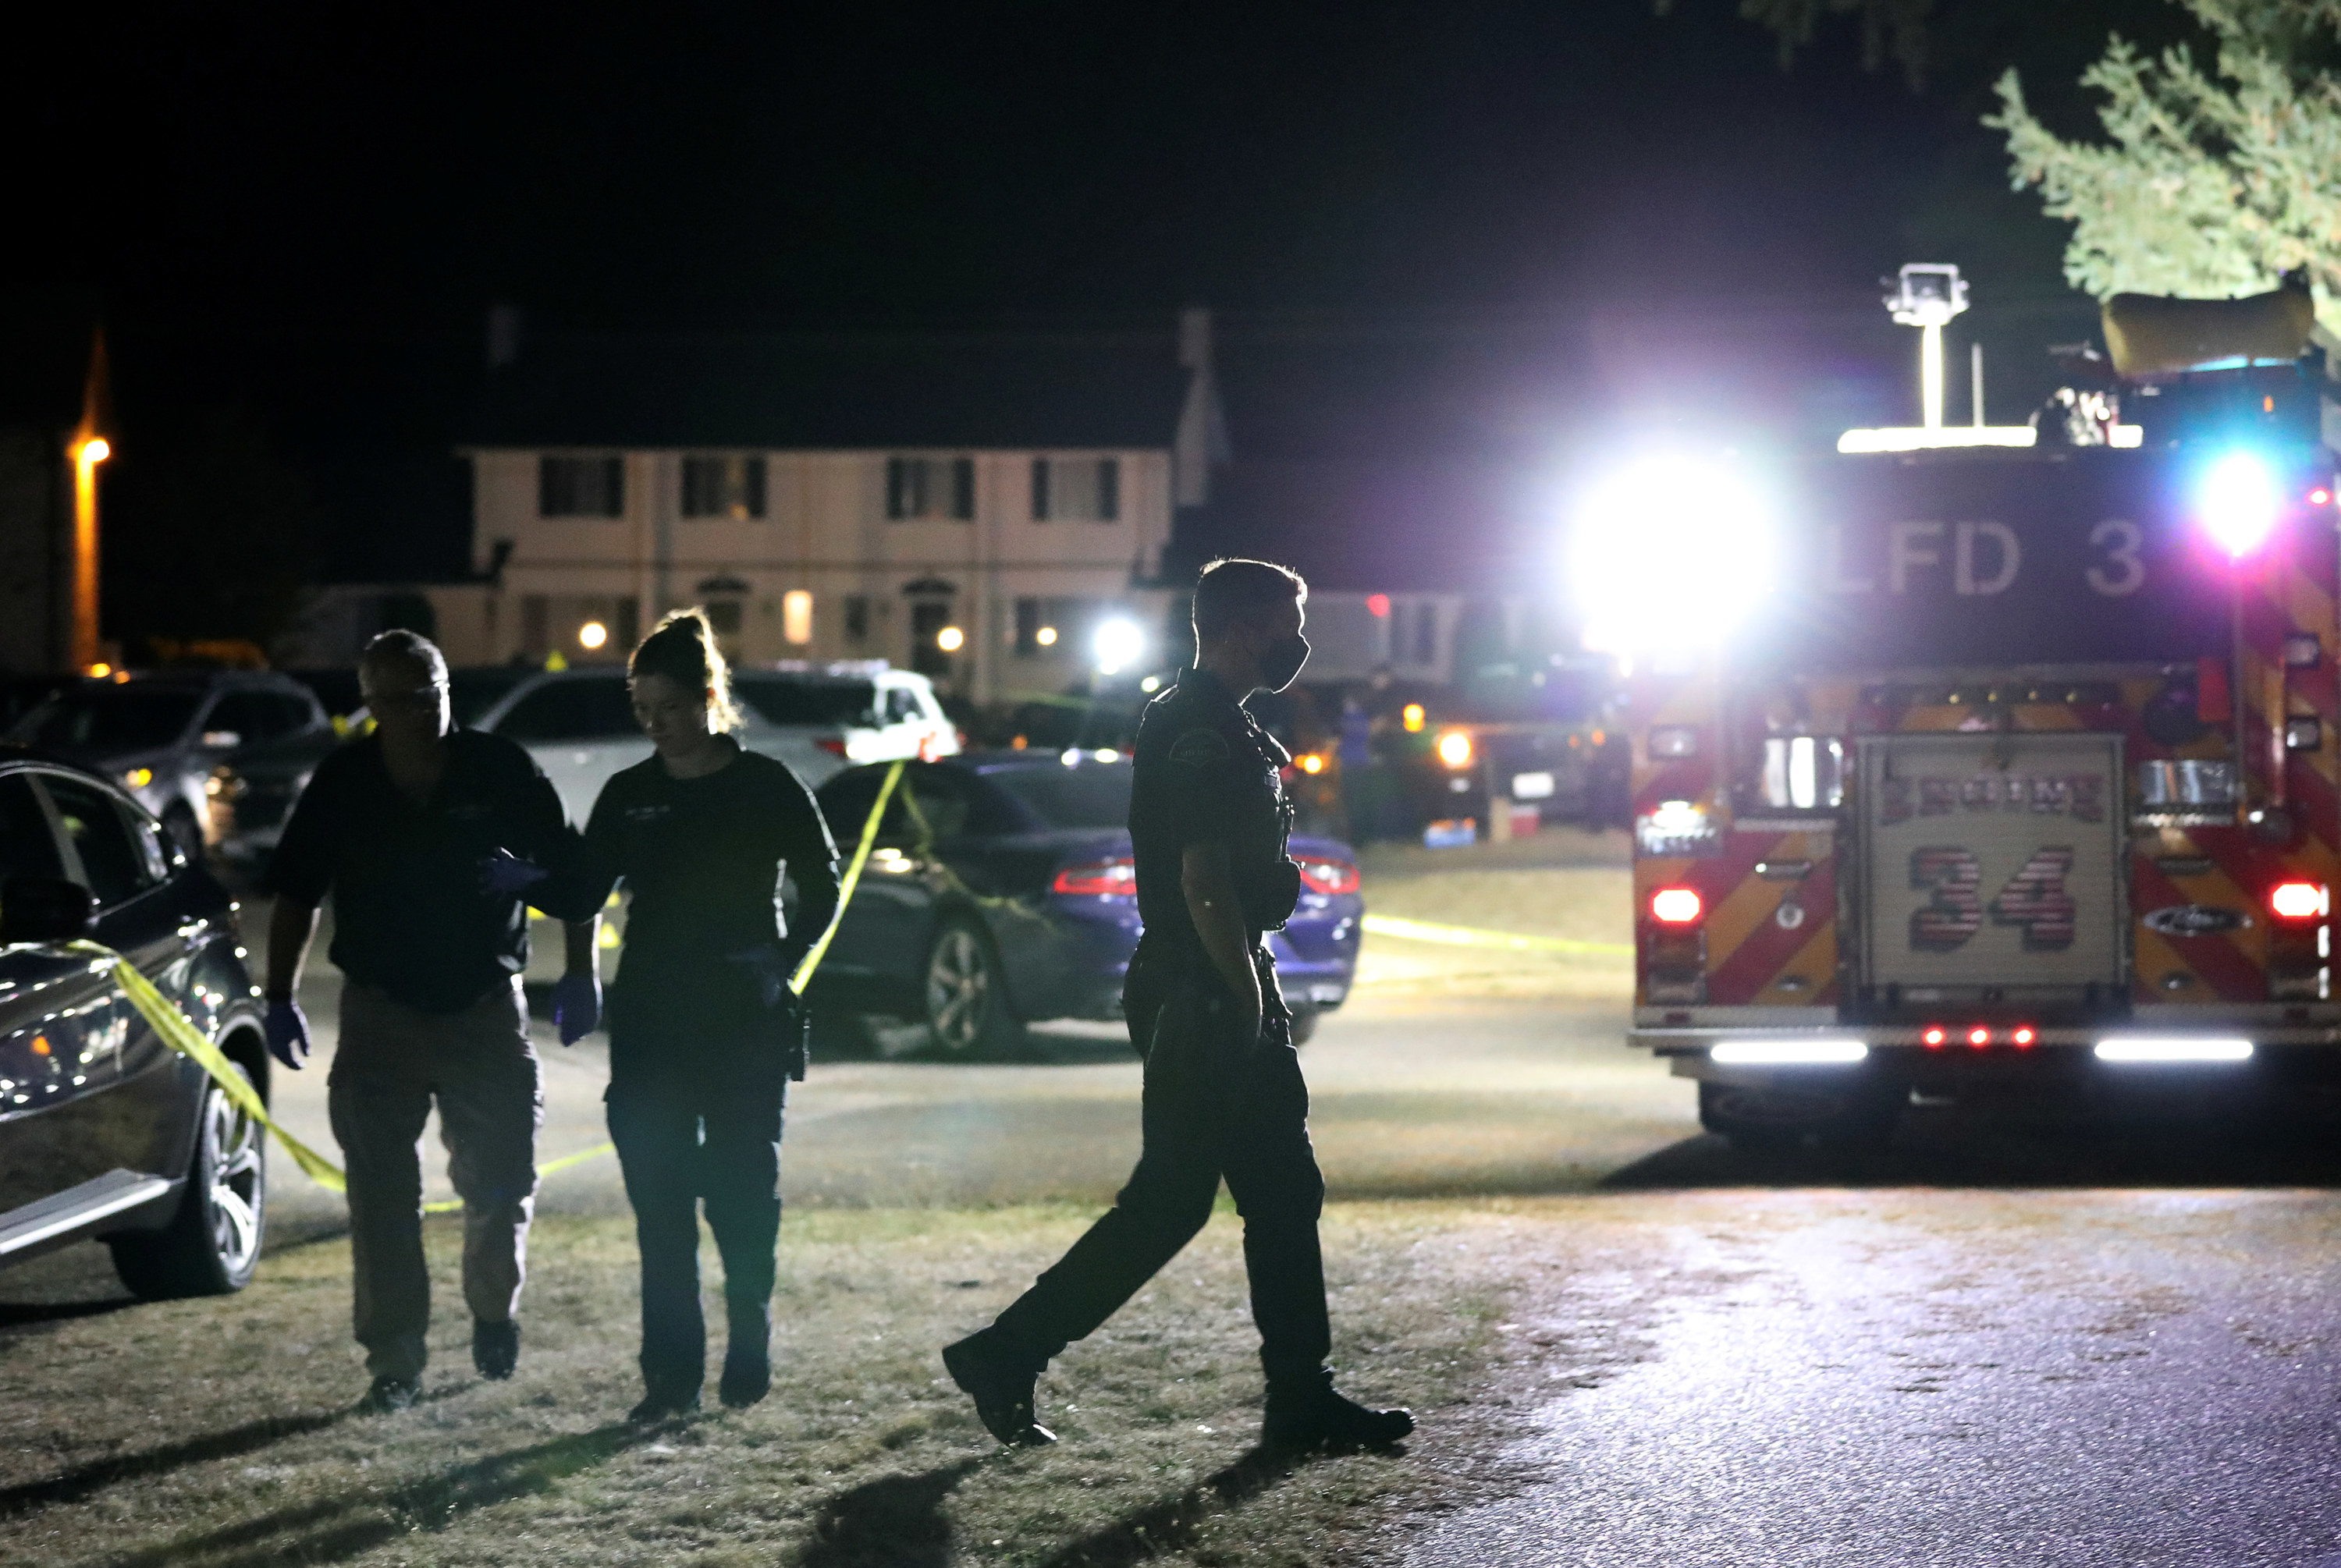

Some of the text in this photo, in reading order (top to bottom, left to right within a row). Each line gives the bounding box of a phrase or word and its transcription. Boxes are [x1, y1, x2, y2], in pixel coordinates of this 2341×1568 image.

[1824, 519, 2146, 597] LFD 3
[1909, 845, 2076, 953] 34
